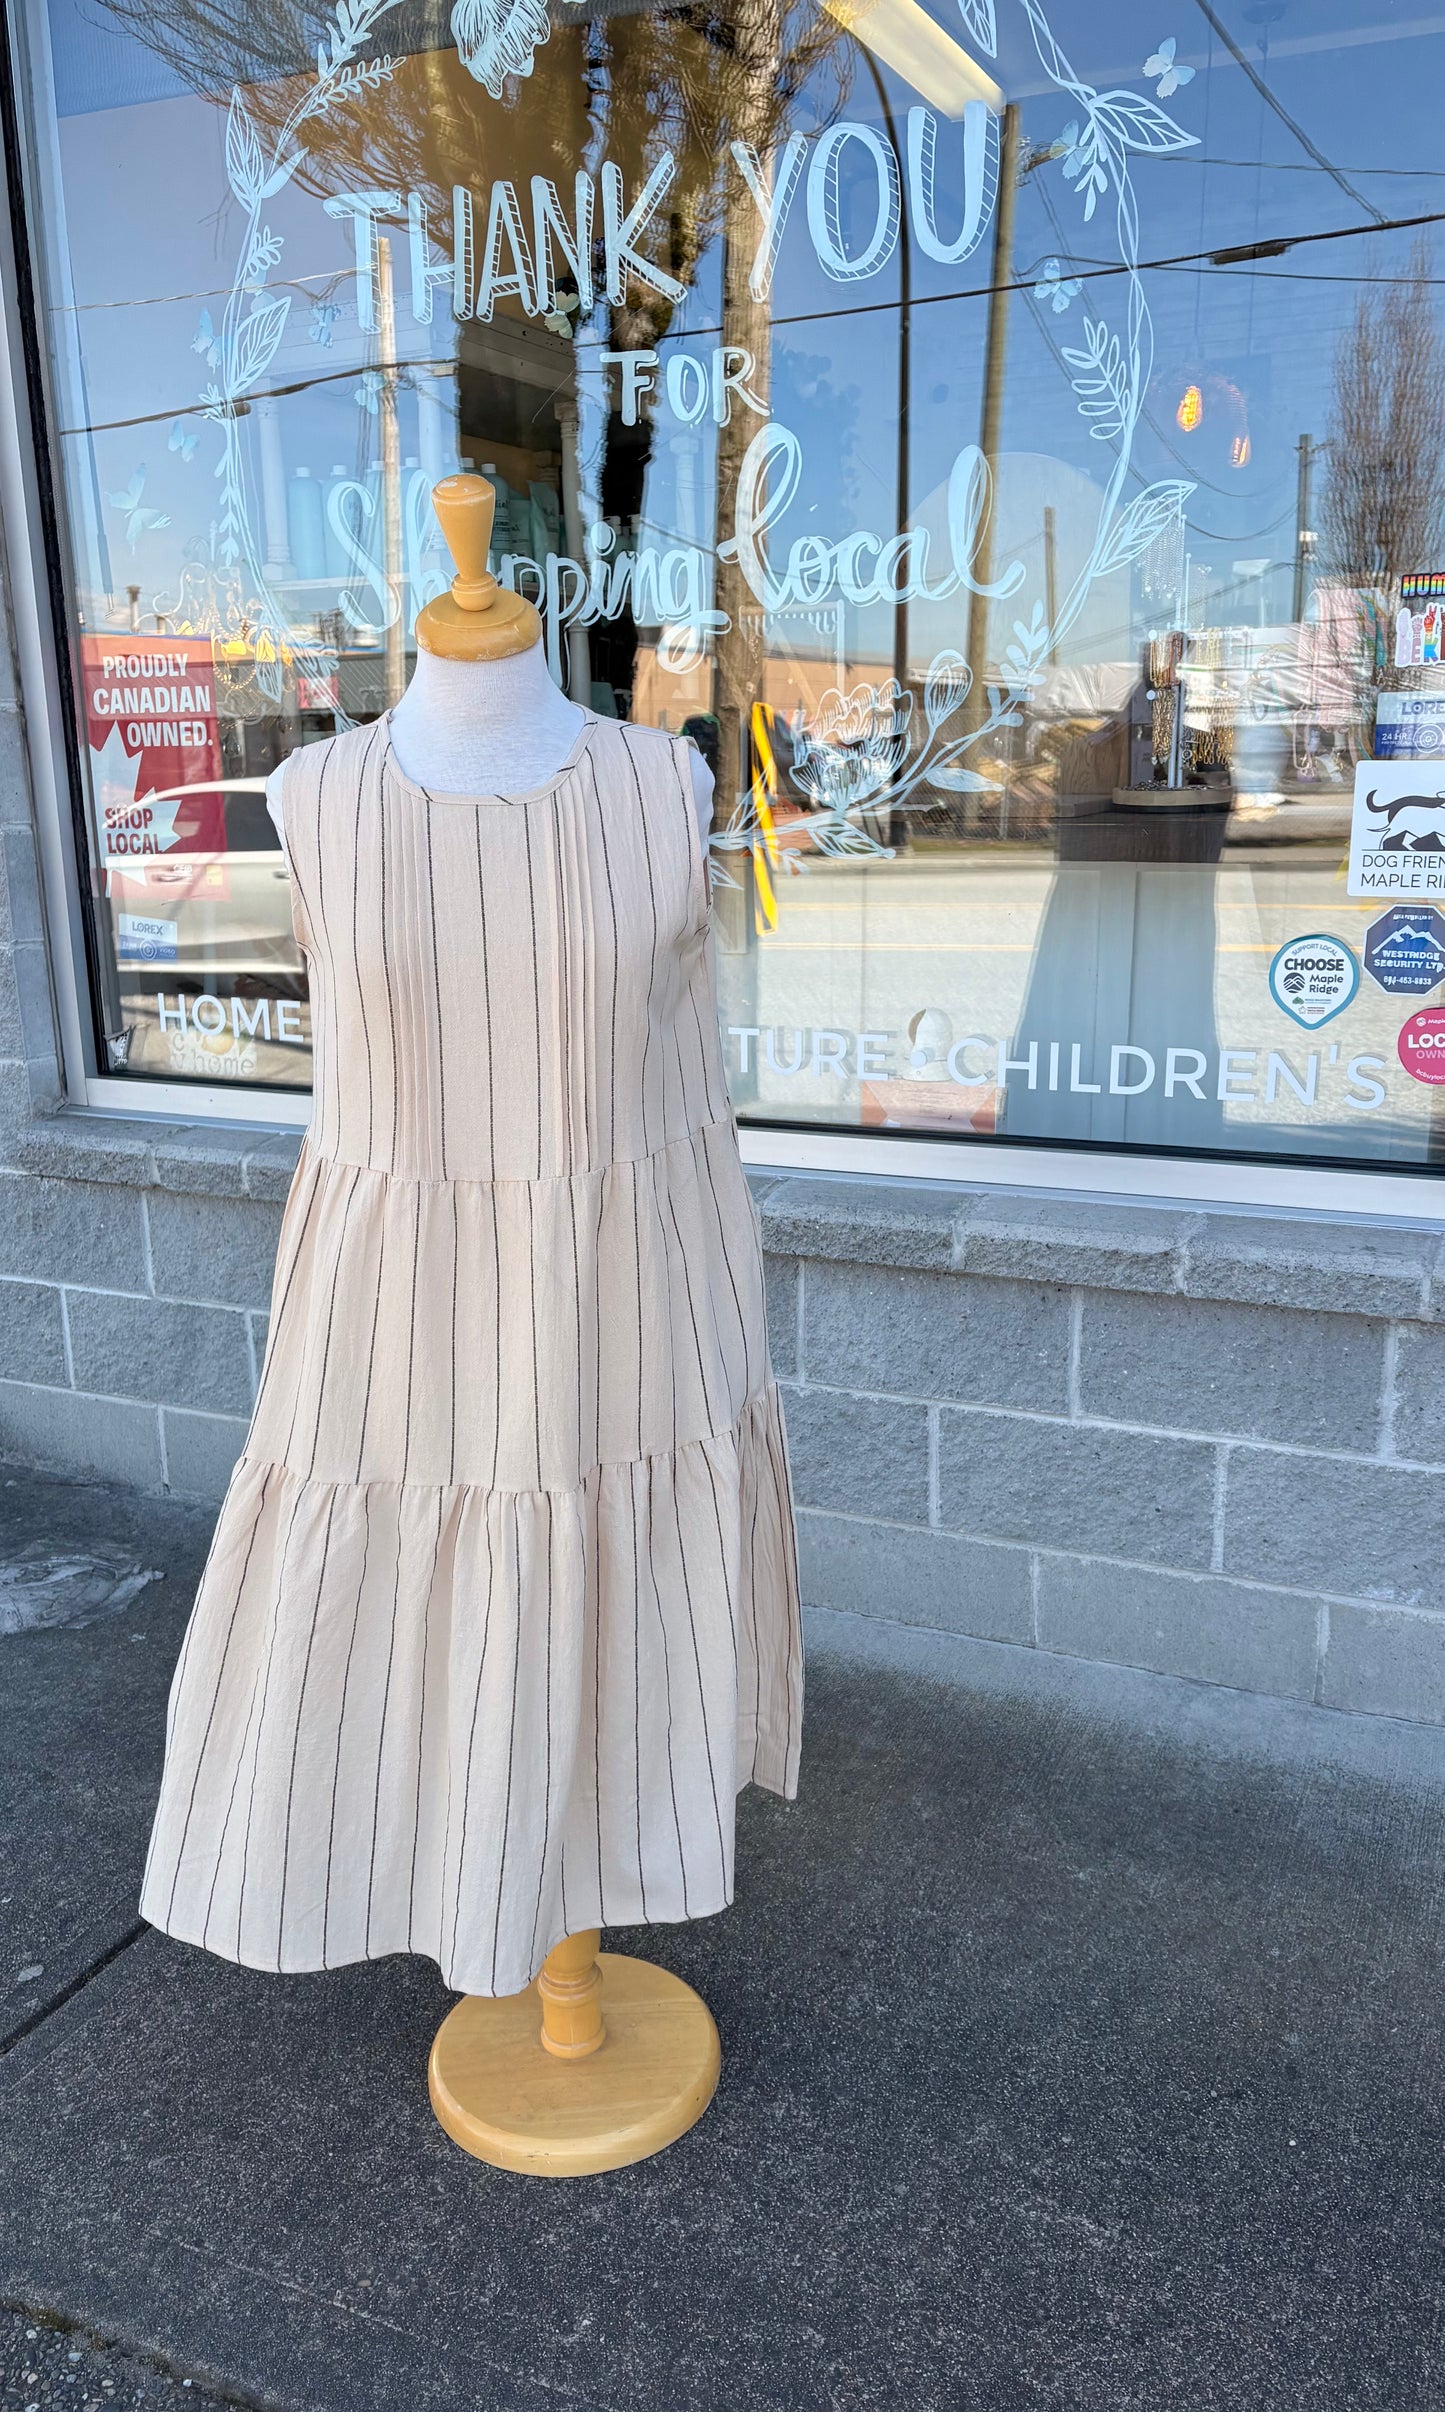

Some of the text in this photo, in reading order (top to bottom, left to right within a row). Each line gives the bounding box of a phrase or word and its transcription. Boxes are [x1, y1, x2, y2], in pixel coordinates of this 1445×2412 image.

[323, 99, 1002, 335] THANK YOU
[600, 346, 770, 427] FOR
[326, 468, 732, 692] Shpping
[102, 653, 189, 679] PROUDLY
[93, 685, 211, 715] CANADIAN
[126, 721, 214, 747] OWNED.
[104, 807, 153, 829] SHOP
[106, 832, 164, 855] LOCAL
[1362, 854, 1398, 868] DOG
[1360, 873, 1421, 888] MAPLE
[132, 921, 163, 935] LOREX
[1291, 943, 1338, 957] SUPPORT LOCAL
[1284, 958, 1345, 971] CHOOSE
[1309, 974, 1344, 984] Maple
[1309, 984, 1339, 995] Ridge
[157, 992, 304, 1043] HOME
[947, 1037, 1387, 1110] CHILDREN'S
